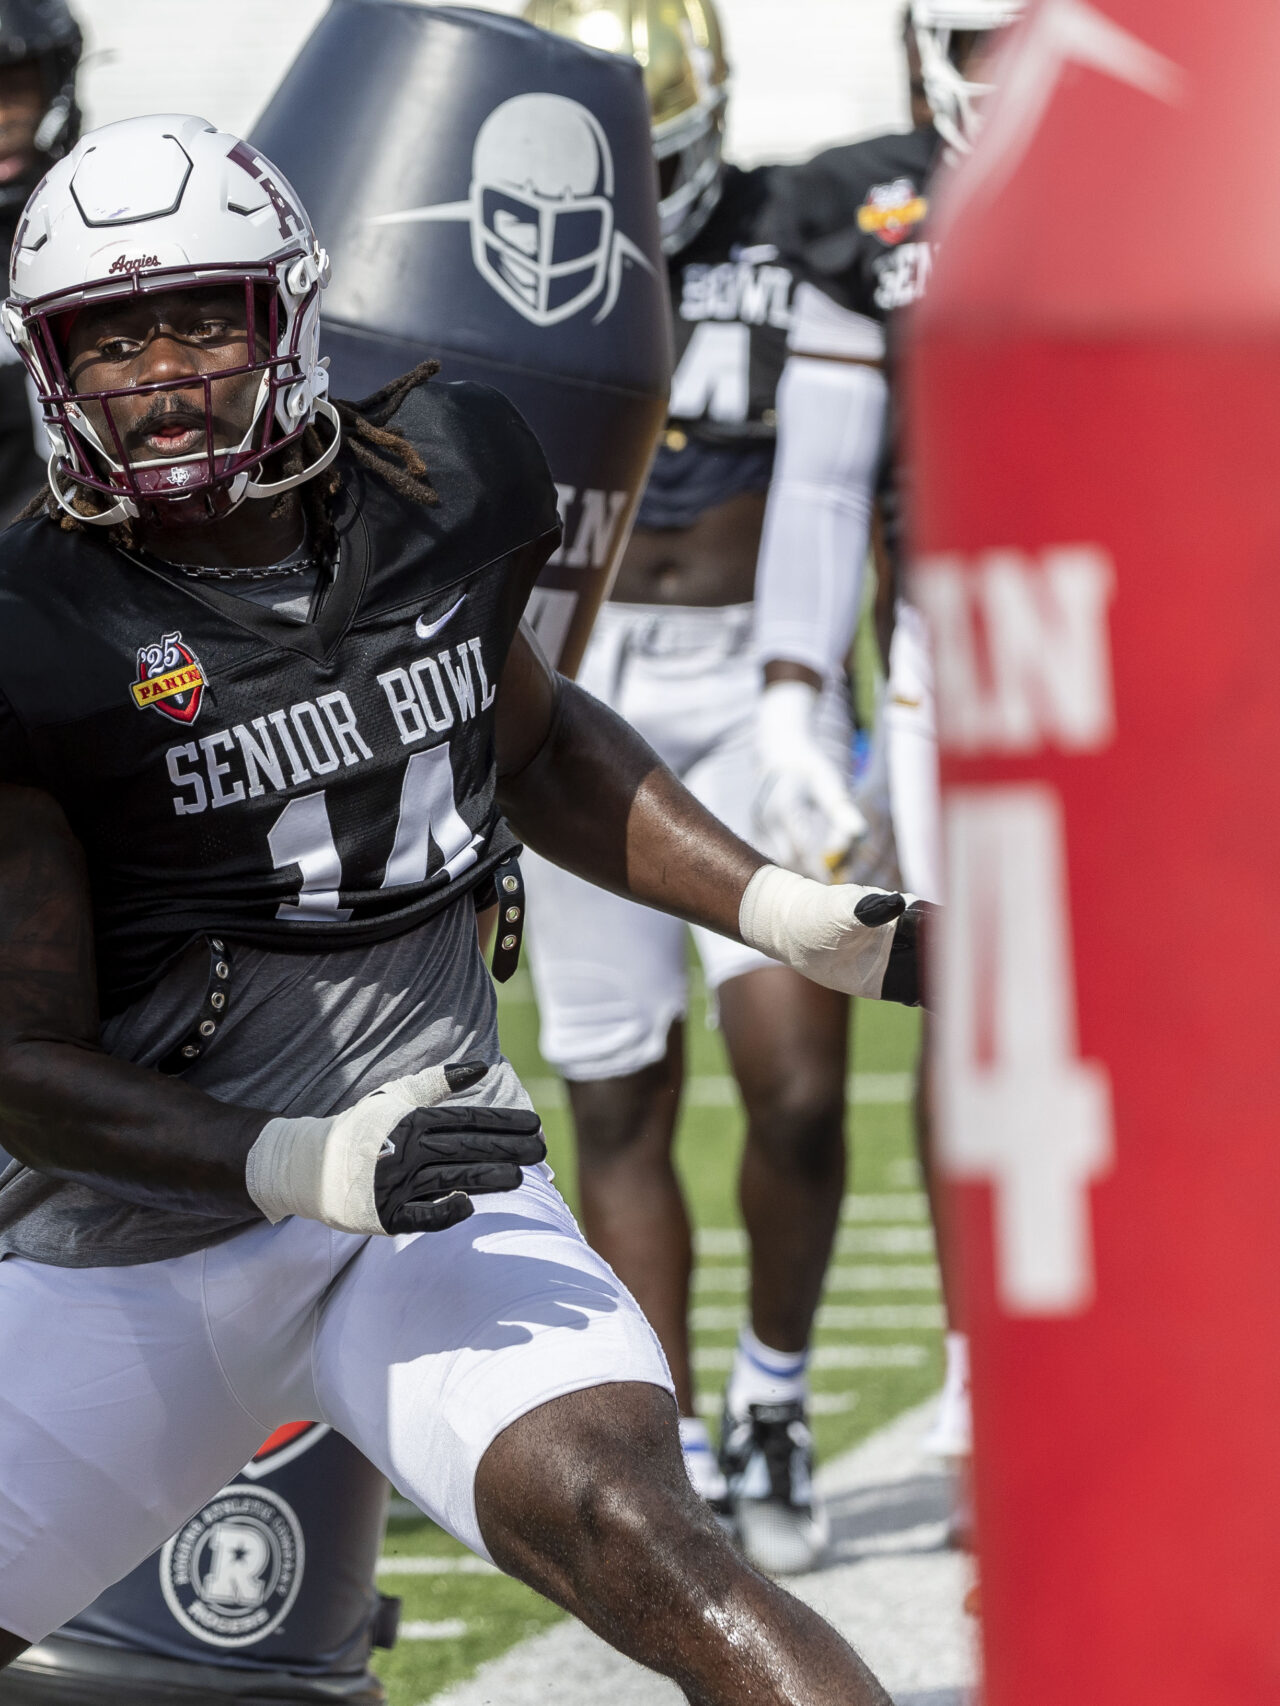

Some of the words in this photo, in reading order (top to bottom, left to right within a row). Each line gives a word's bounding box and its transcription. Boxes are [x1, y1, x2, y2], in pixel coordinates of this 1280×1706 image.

[109, 254, 162, 275] Aggies
[141, 635, 180, 678] '25
[138, 669, 201, 700] PANIN
[165, 689, 373, 815] SENIOR
[376, 636, 497, 746] BOWL
[267, 740, 485, 922] 14
